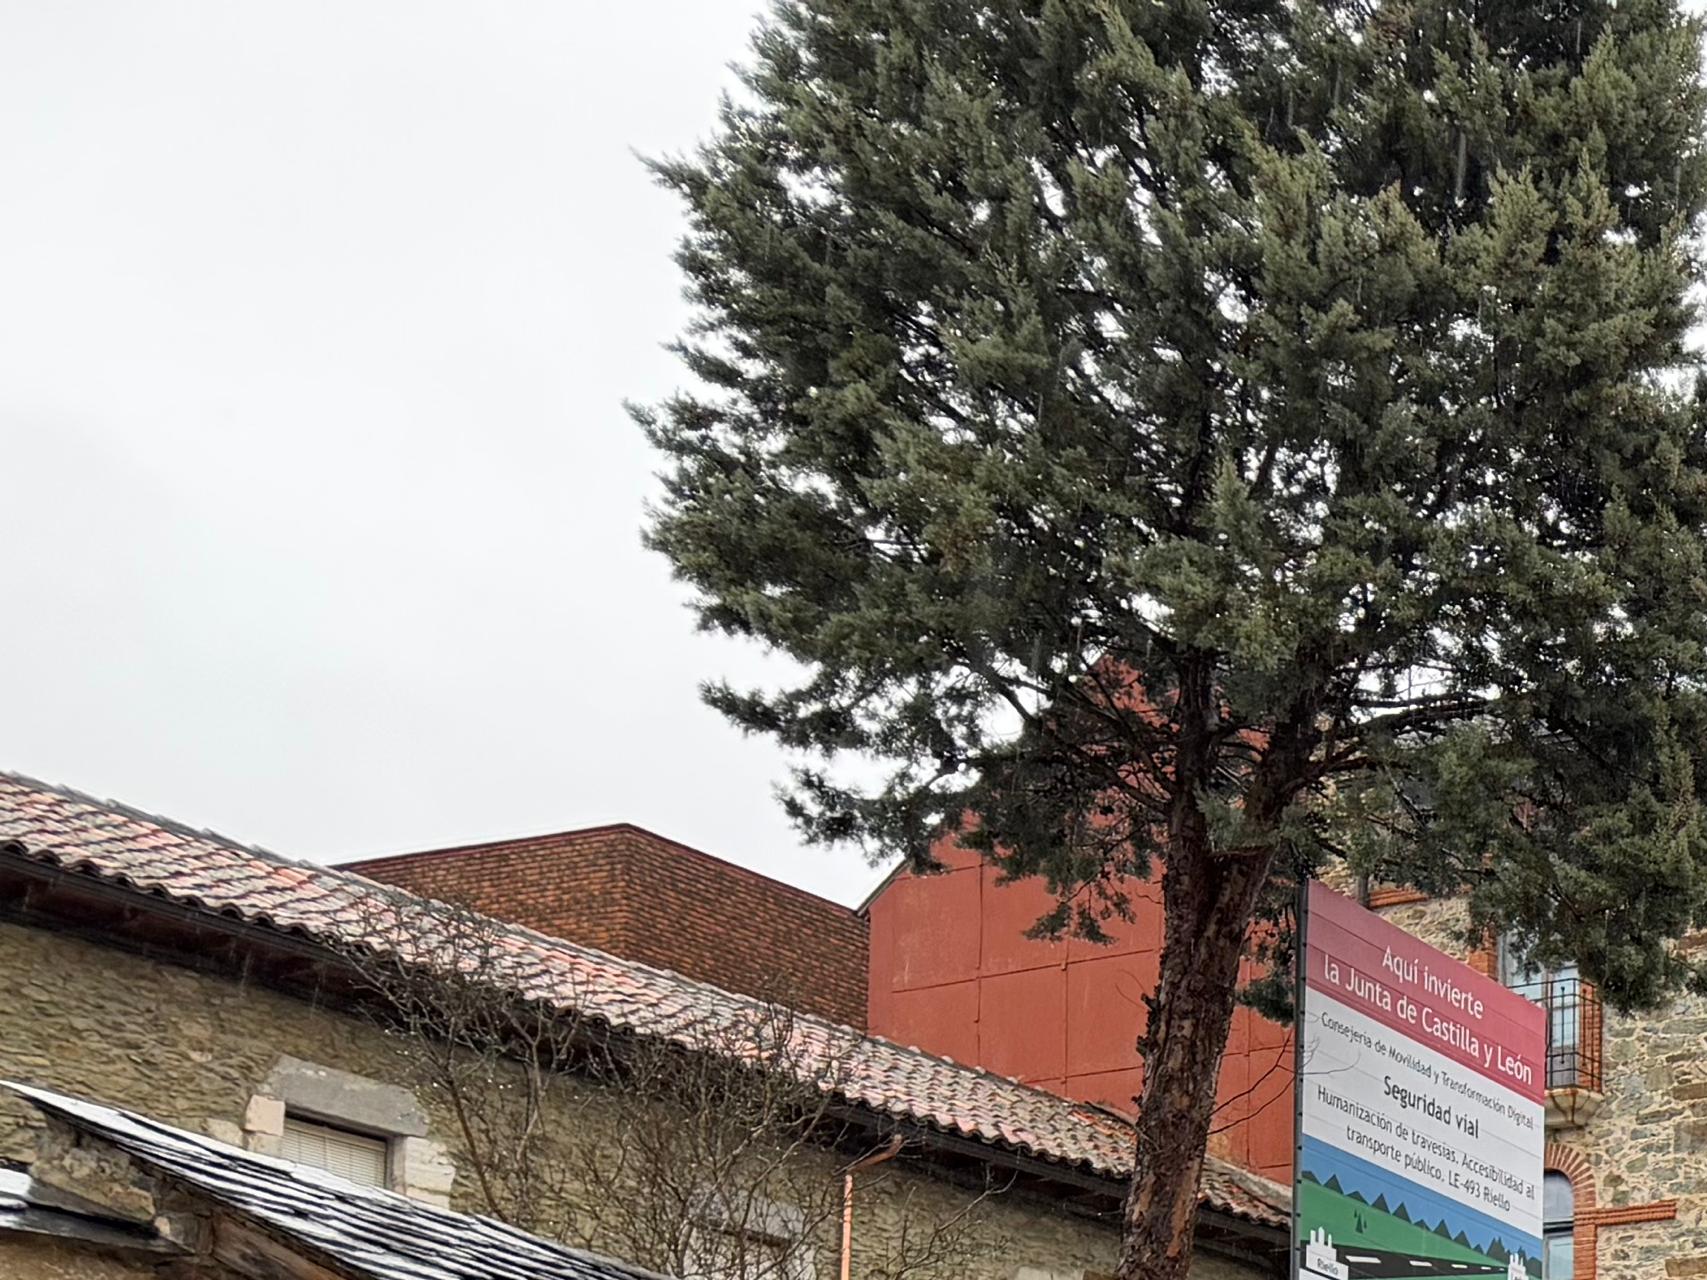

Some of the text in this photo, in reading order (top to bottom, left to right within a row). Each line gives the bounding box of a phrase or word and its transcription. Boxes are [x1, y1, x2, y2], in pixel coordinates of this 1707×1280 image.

[1325, 955, 1532, 1085] la Junta de Castilla y León
[1382, 946, 1484, 1019] Aquí invierte
[1375, 1039, 1387, 1057] de
[1434, 1071, 1440, 1086] y
[1507, 1104, 1534, 1130] Digital
[1384, 1075, 1479, 1139] Seguridad vial
[1317, 1085, 1392, 1133] Humanización
[1396, 1122, 1408, 1141] de
[1462, 1153, 1524, 1194] Accesibilidad
[1526, 1184, 1535, 1200] al
[1346, 1125, 1511, 1212] transporte público. LE-493 Riello
